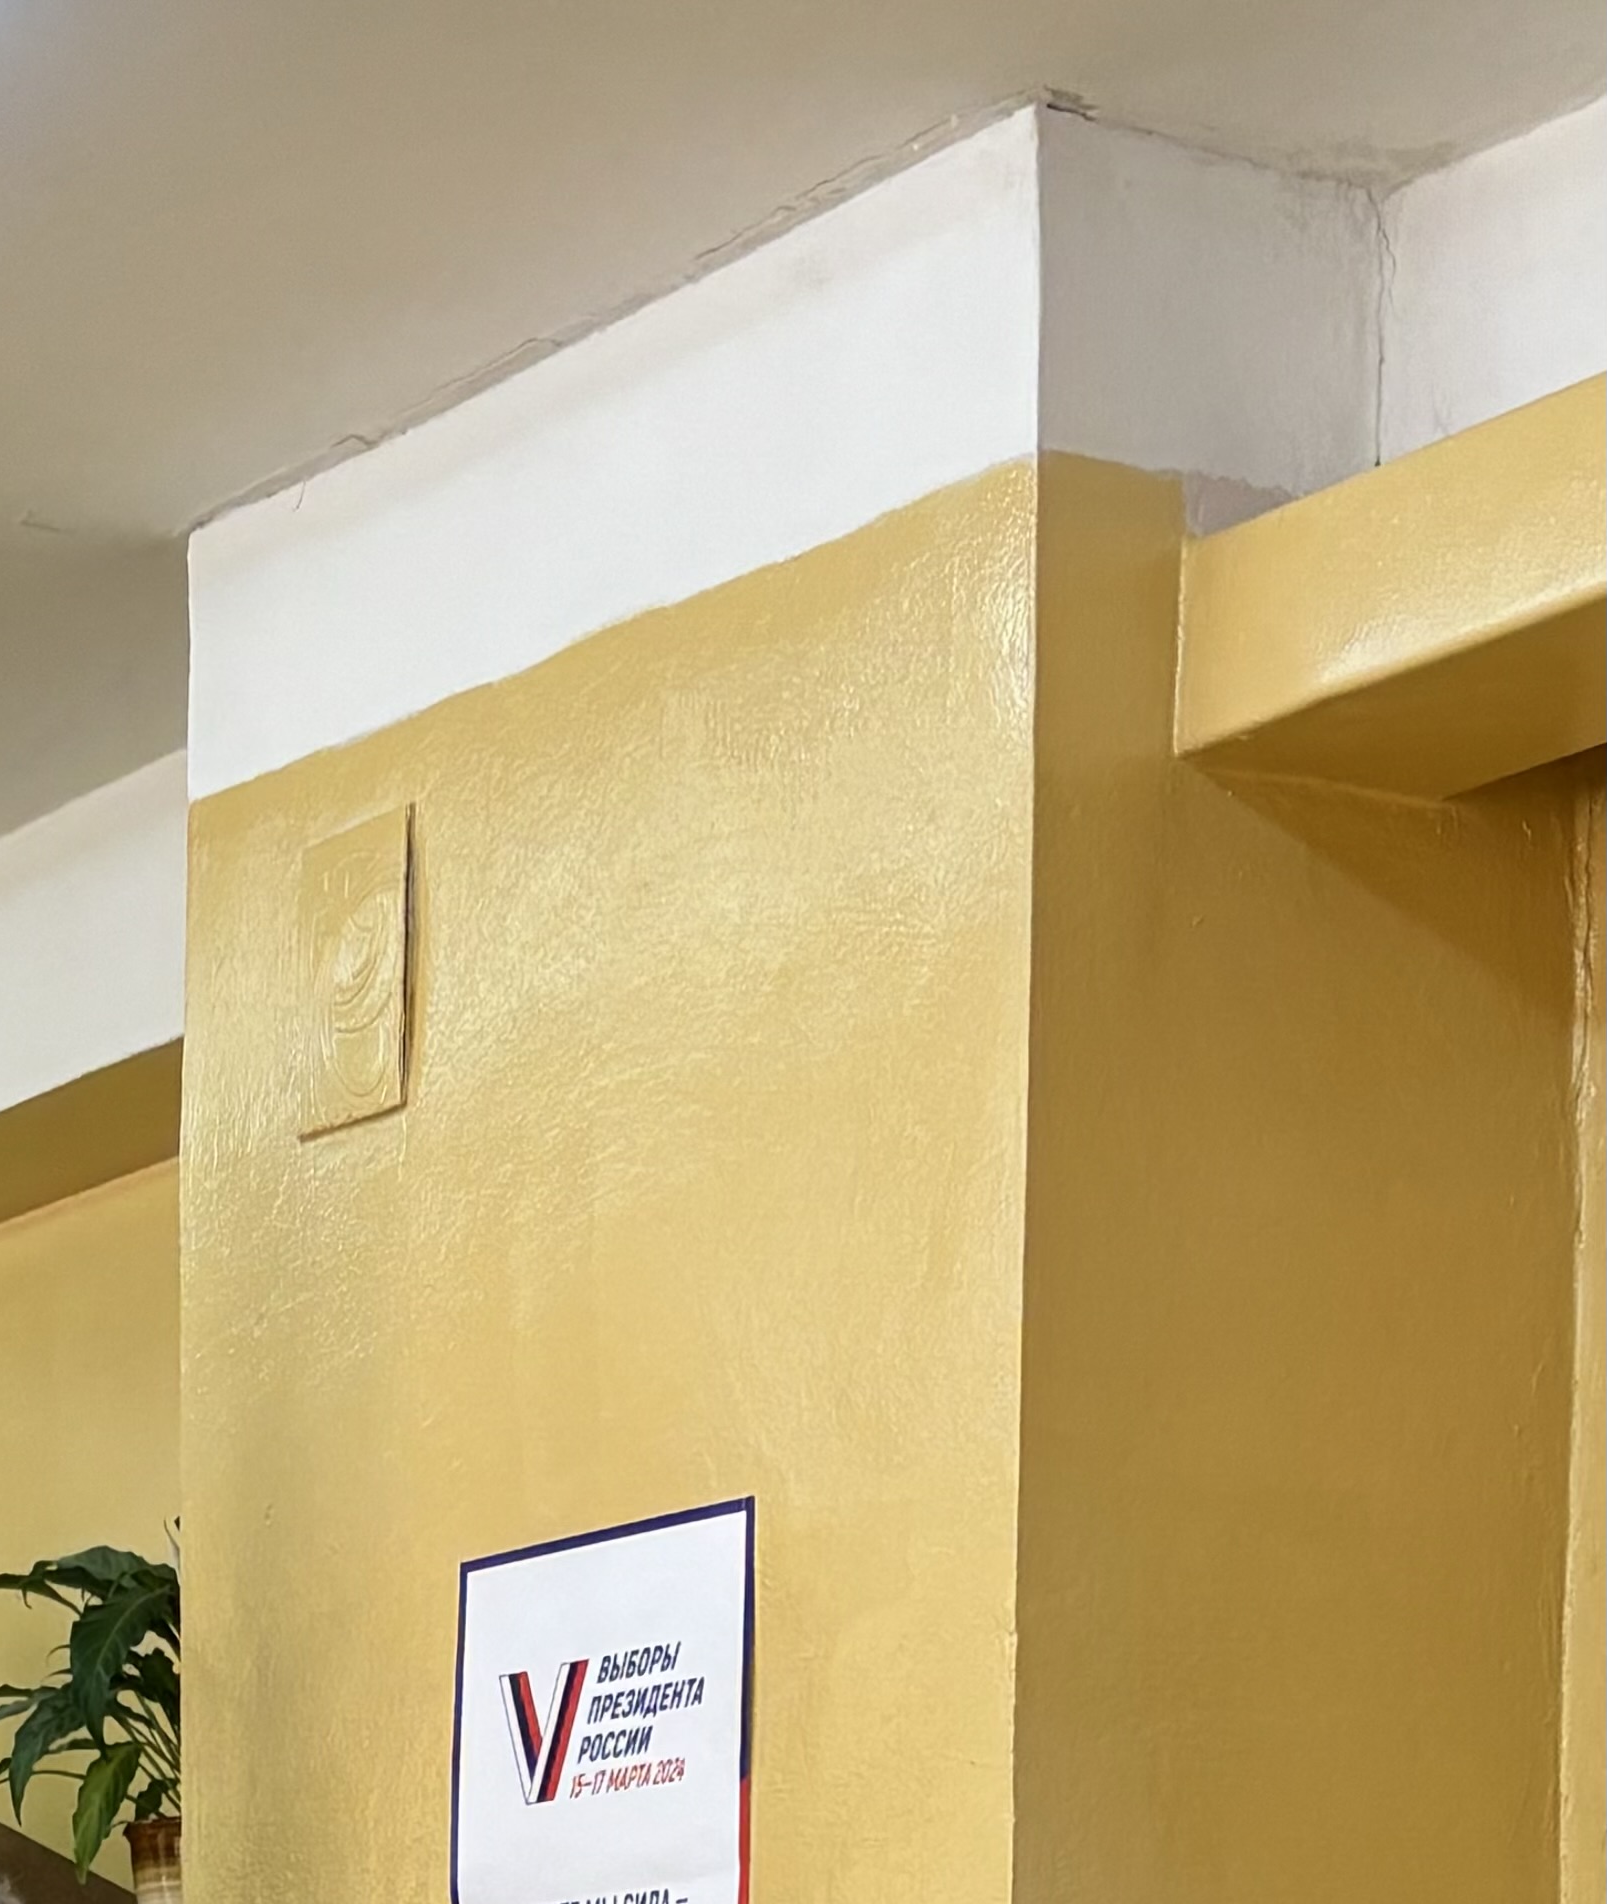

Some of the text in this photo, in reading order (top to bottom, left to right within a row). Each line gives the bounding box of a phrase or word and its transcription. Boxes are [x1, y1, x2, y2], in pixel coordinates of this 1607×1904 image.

[596, 1640, 682, 1684] ВЫБОРЫ
[587, 1676, 705, 1725] ПРЕЗИДЕНТА
[577, 1725, 653, 1764] РОССИИ
[606, 1762, 652, 1794] МАРТА
[652, 1757, 686, 1785] 2024
